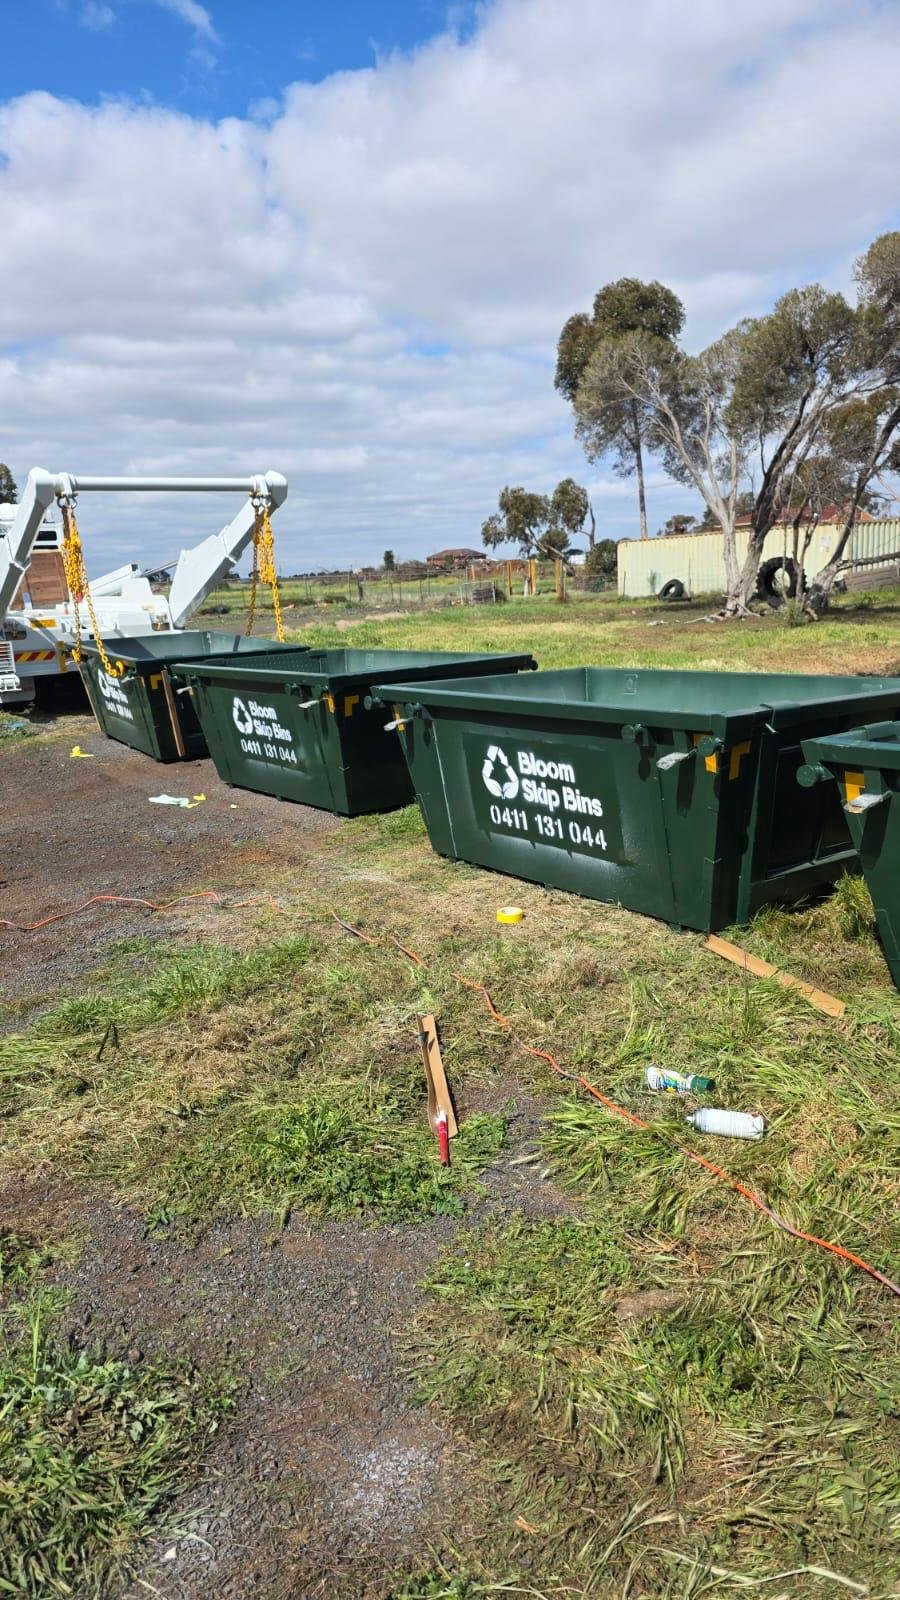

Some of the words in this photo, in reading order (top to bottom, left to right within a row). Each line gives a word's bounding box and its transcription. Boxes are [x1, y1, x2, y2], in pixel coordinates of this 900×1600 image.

[248, 700, 277, 721] Bloom
[253, 719, 273, 741] Skip
[272, 722, 292, 742] Bins
[240, 738, 262, 756] 0411
[263, 743, 278, 759] 131
[279, 746, 297, 764] 044
[517, 751, 576, 784] Bloom
[522, 778, 560, 812] Skip
[562, 786, 603, 817] Bins
[490, 804, 528, 831] 0411
[534, 814, 564, 839] 131
[569, 821, 608, 851] 044
